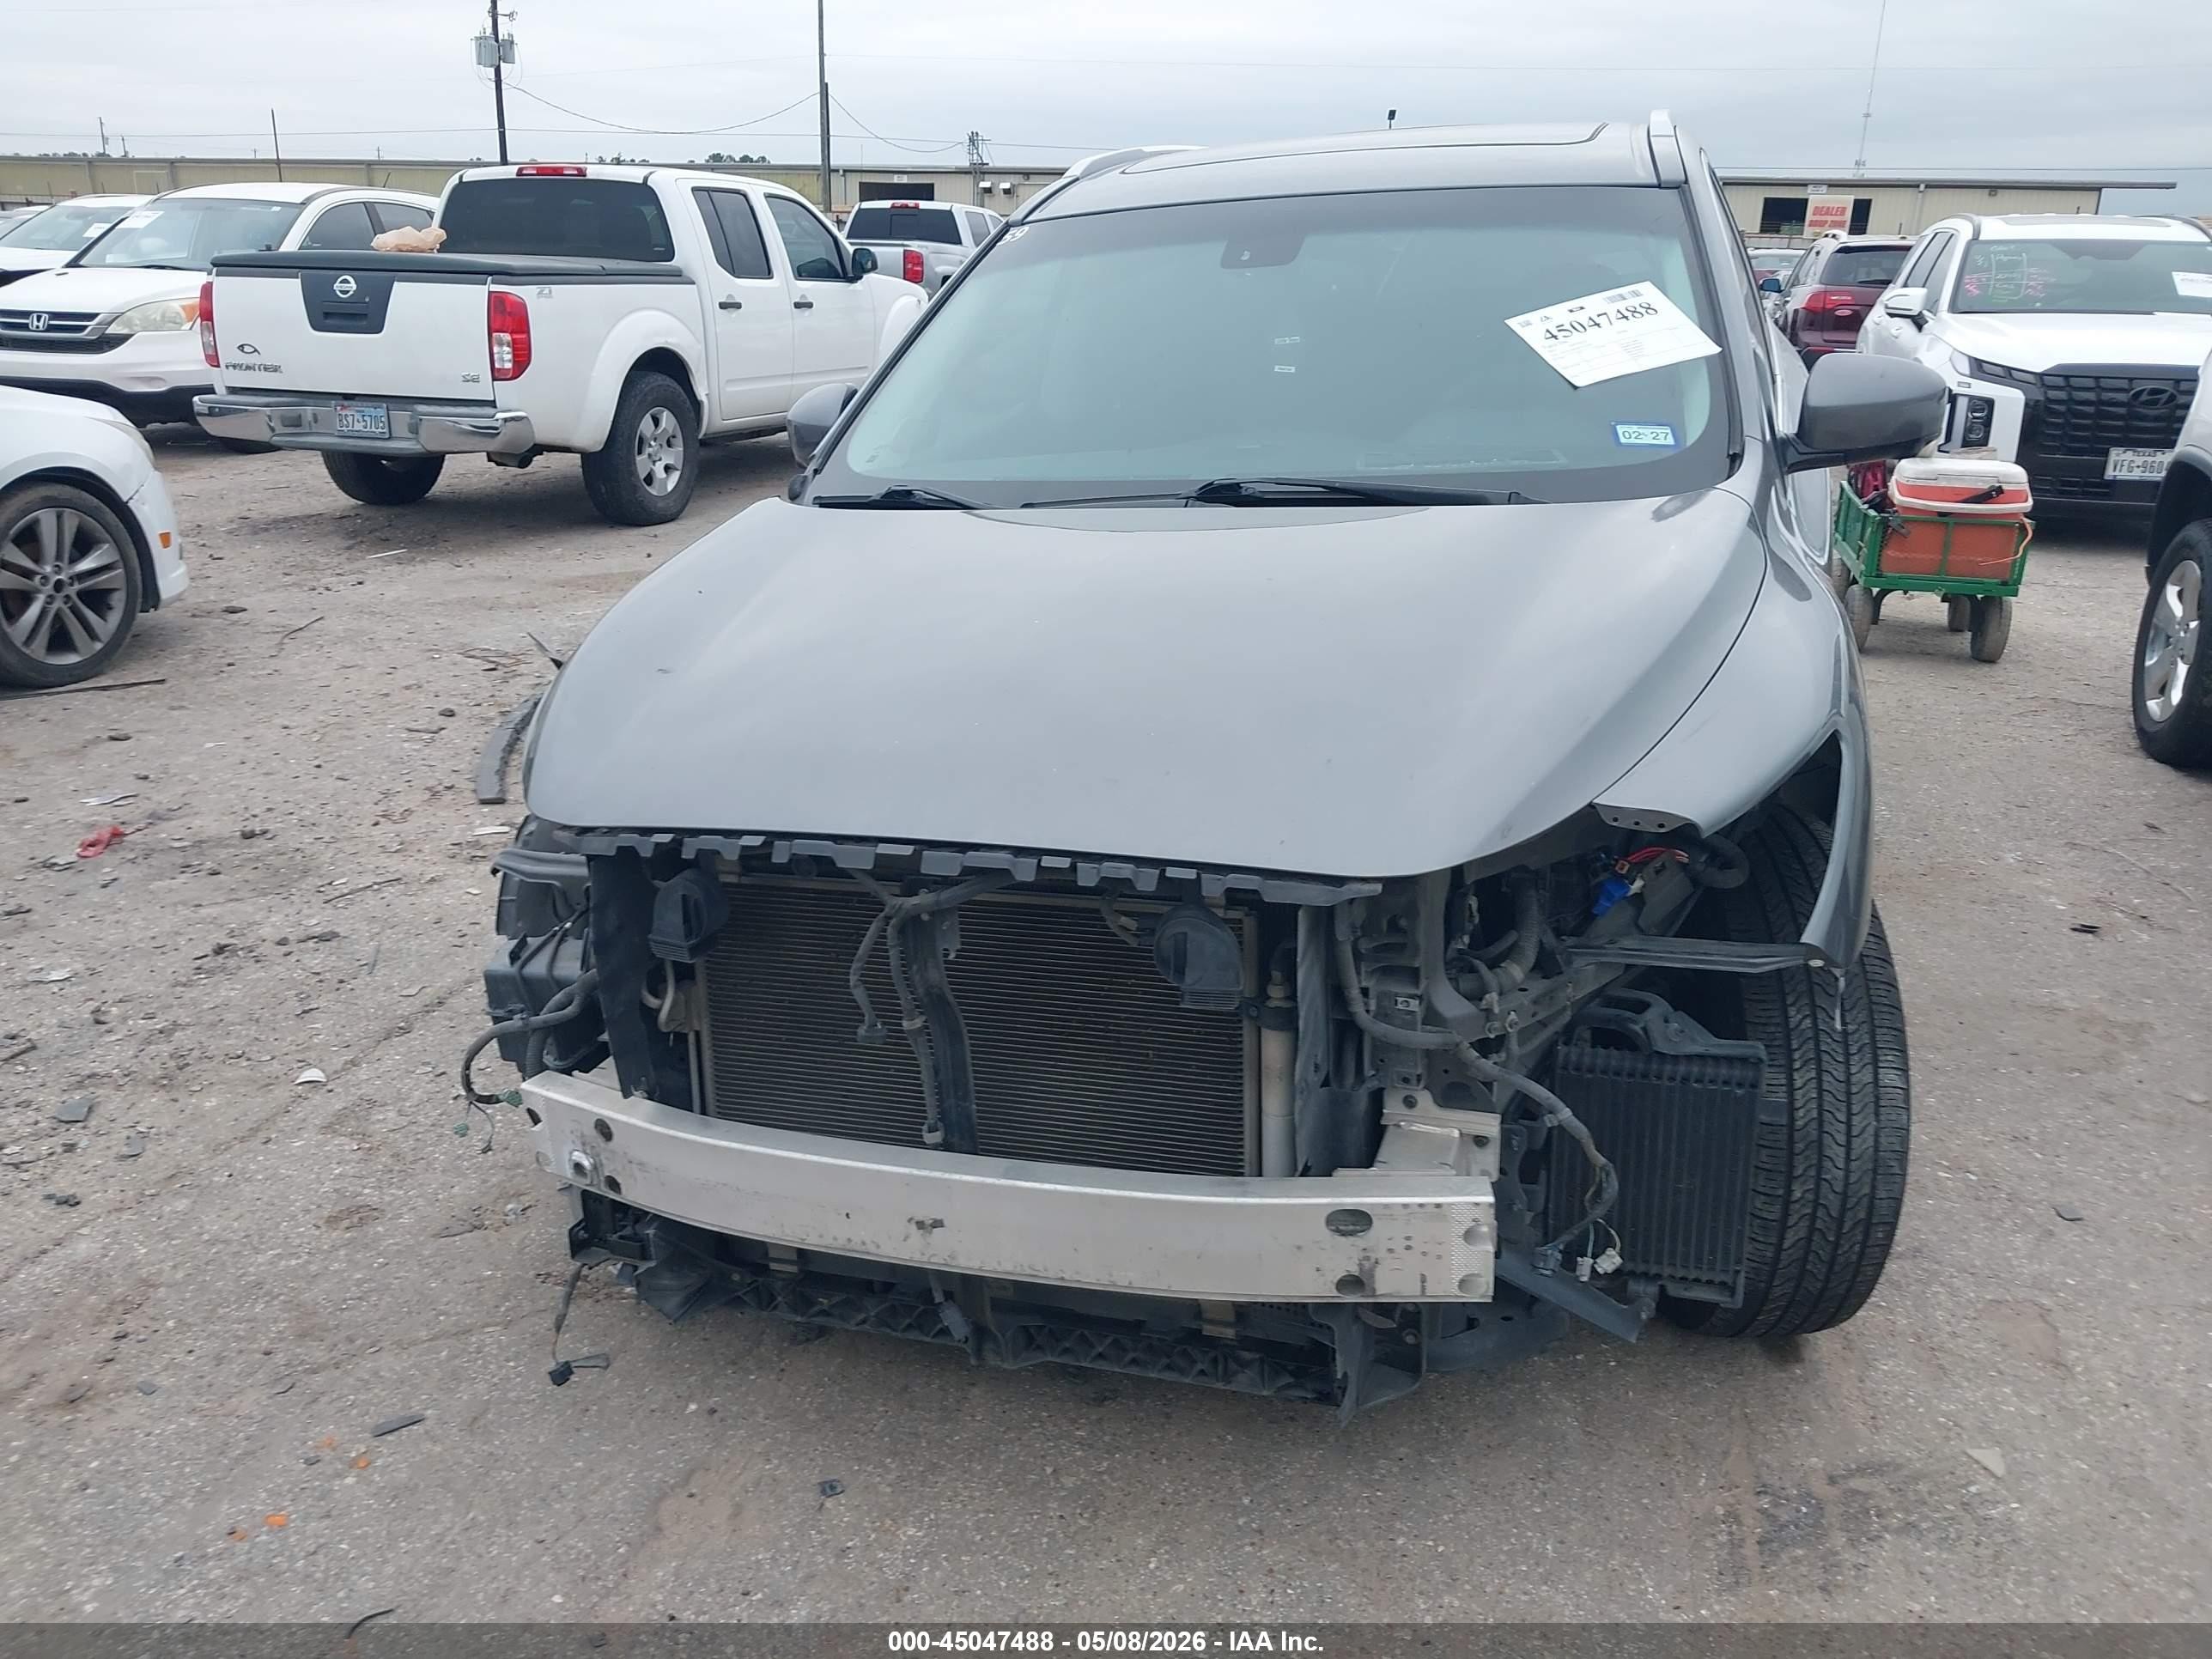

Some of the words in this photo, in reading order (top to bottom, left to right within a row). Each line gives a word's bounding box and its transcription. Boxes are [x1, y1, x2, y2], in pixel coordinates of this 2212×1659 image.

[1813, 206, 1847, 216] DEALER
[1544, 302, 1658, 340] 45047488
[225, 362, 283, 374] FRONTIER
